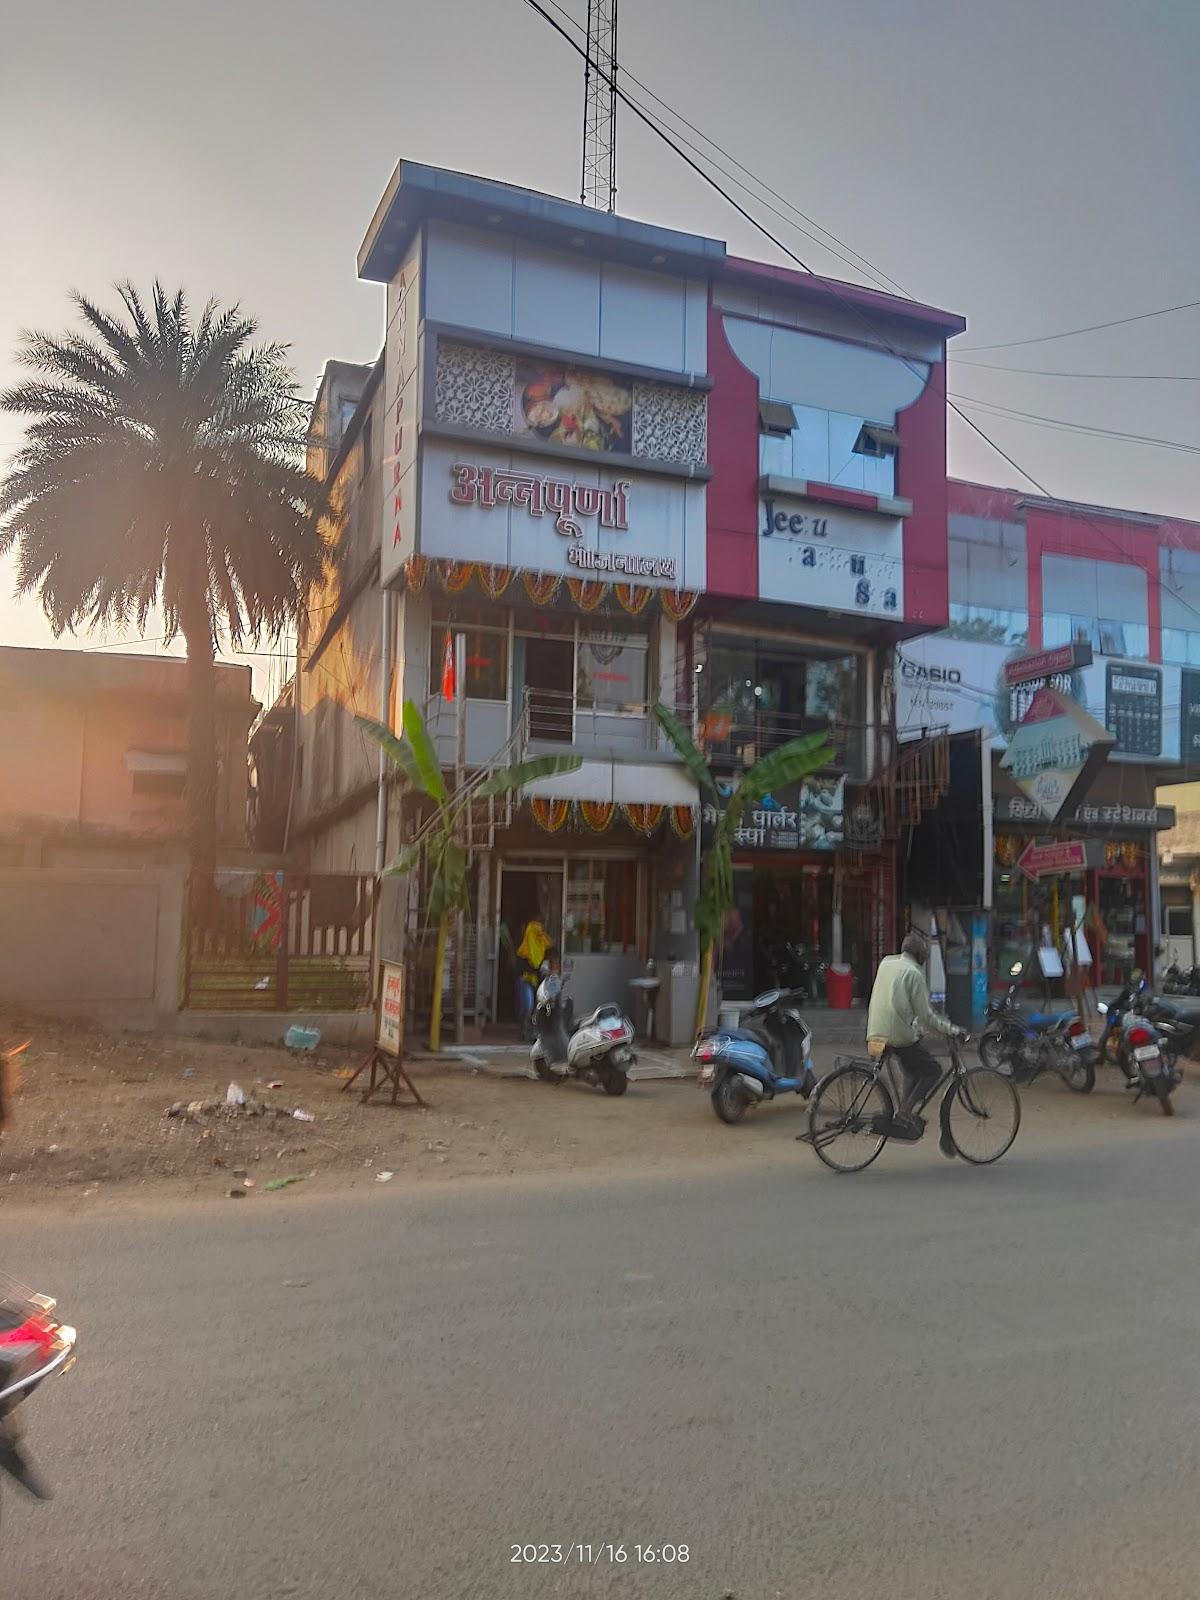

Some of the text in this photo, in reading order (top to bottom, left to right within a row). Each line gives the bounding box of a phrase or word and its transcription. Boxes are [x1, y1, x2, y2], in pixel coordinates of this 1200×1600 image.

[449, 462, 631, 538] अन्नपूर्णा
[901, 661, 961, 684] CASIO
[751, 806, 798, 829] पार्लर
